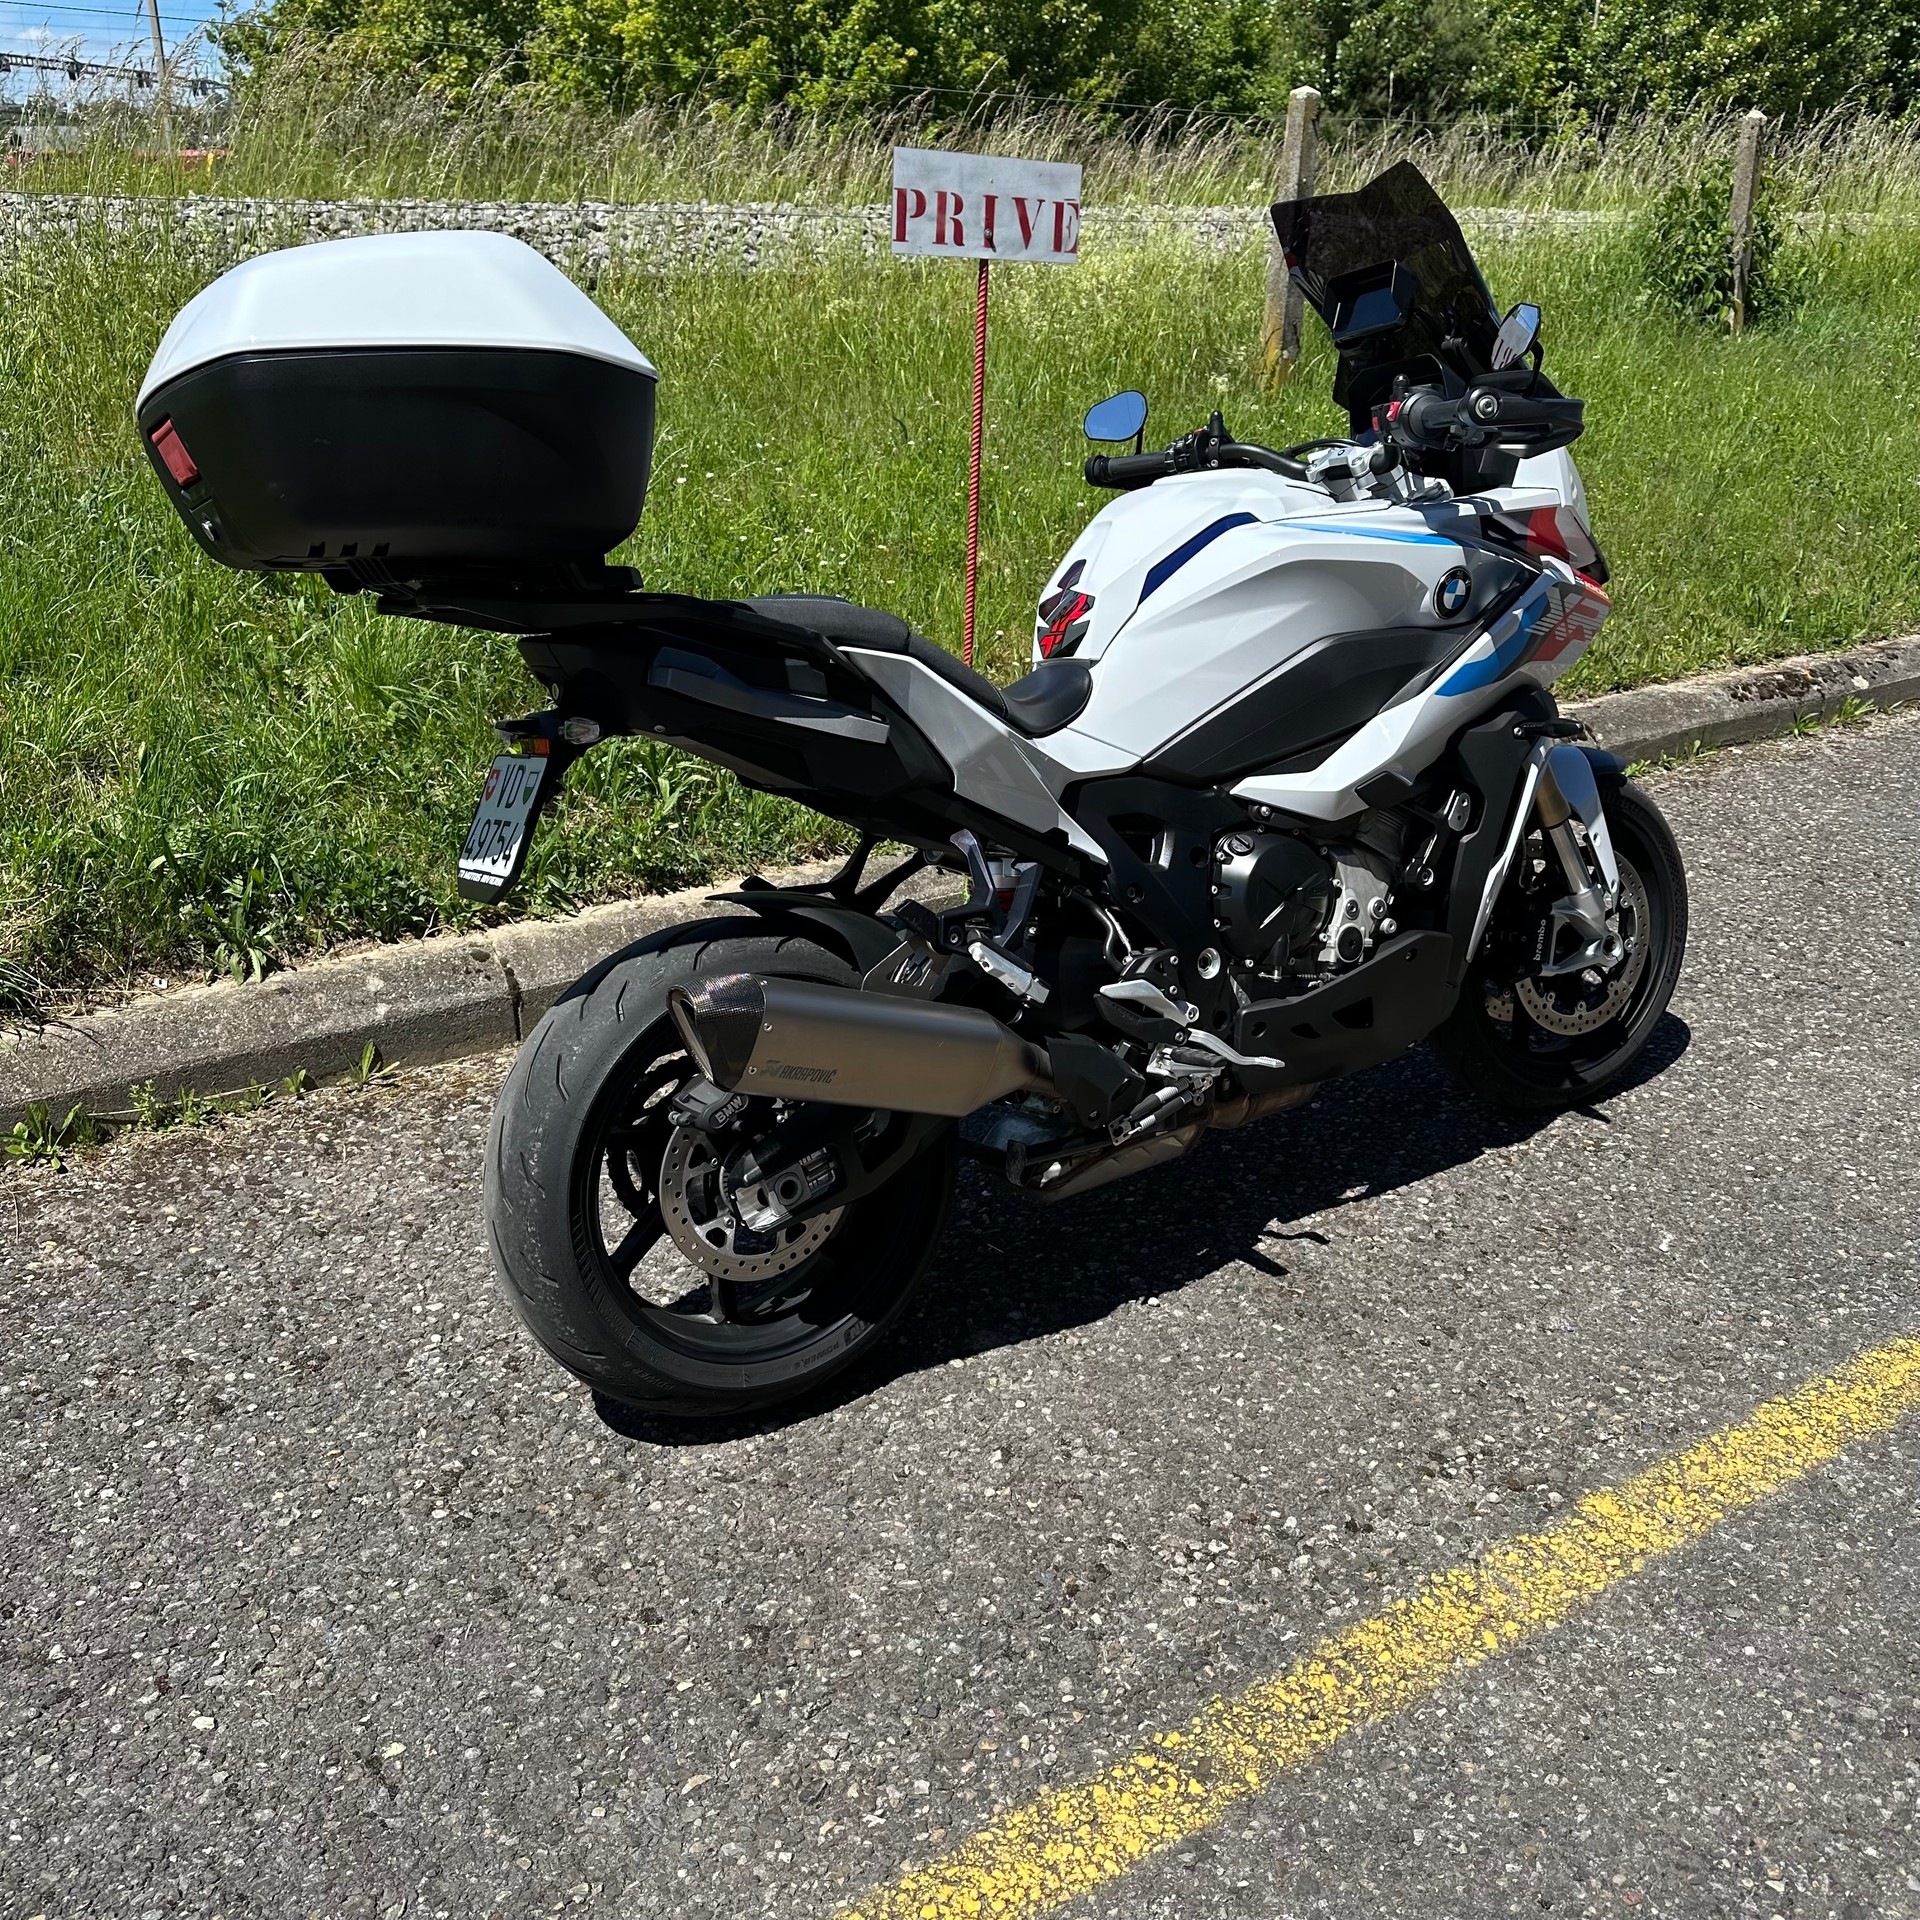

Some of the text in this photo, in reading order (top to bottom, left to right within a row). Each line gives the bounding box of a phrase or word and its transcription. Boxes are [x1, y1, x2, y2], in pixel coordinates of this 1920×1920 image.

[496, 764, 527, 809] VD
[464, 817, 519, 869] 49754
[1533, 919, 1546, 961] brembo
[715, 1095, 743, 1124] BMW
